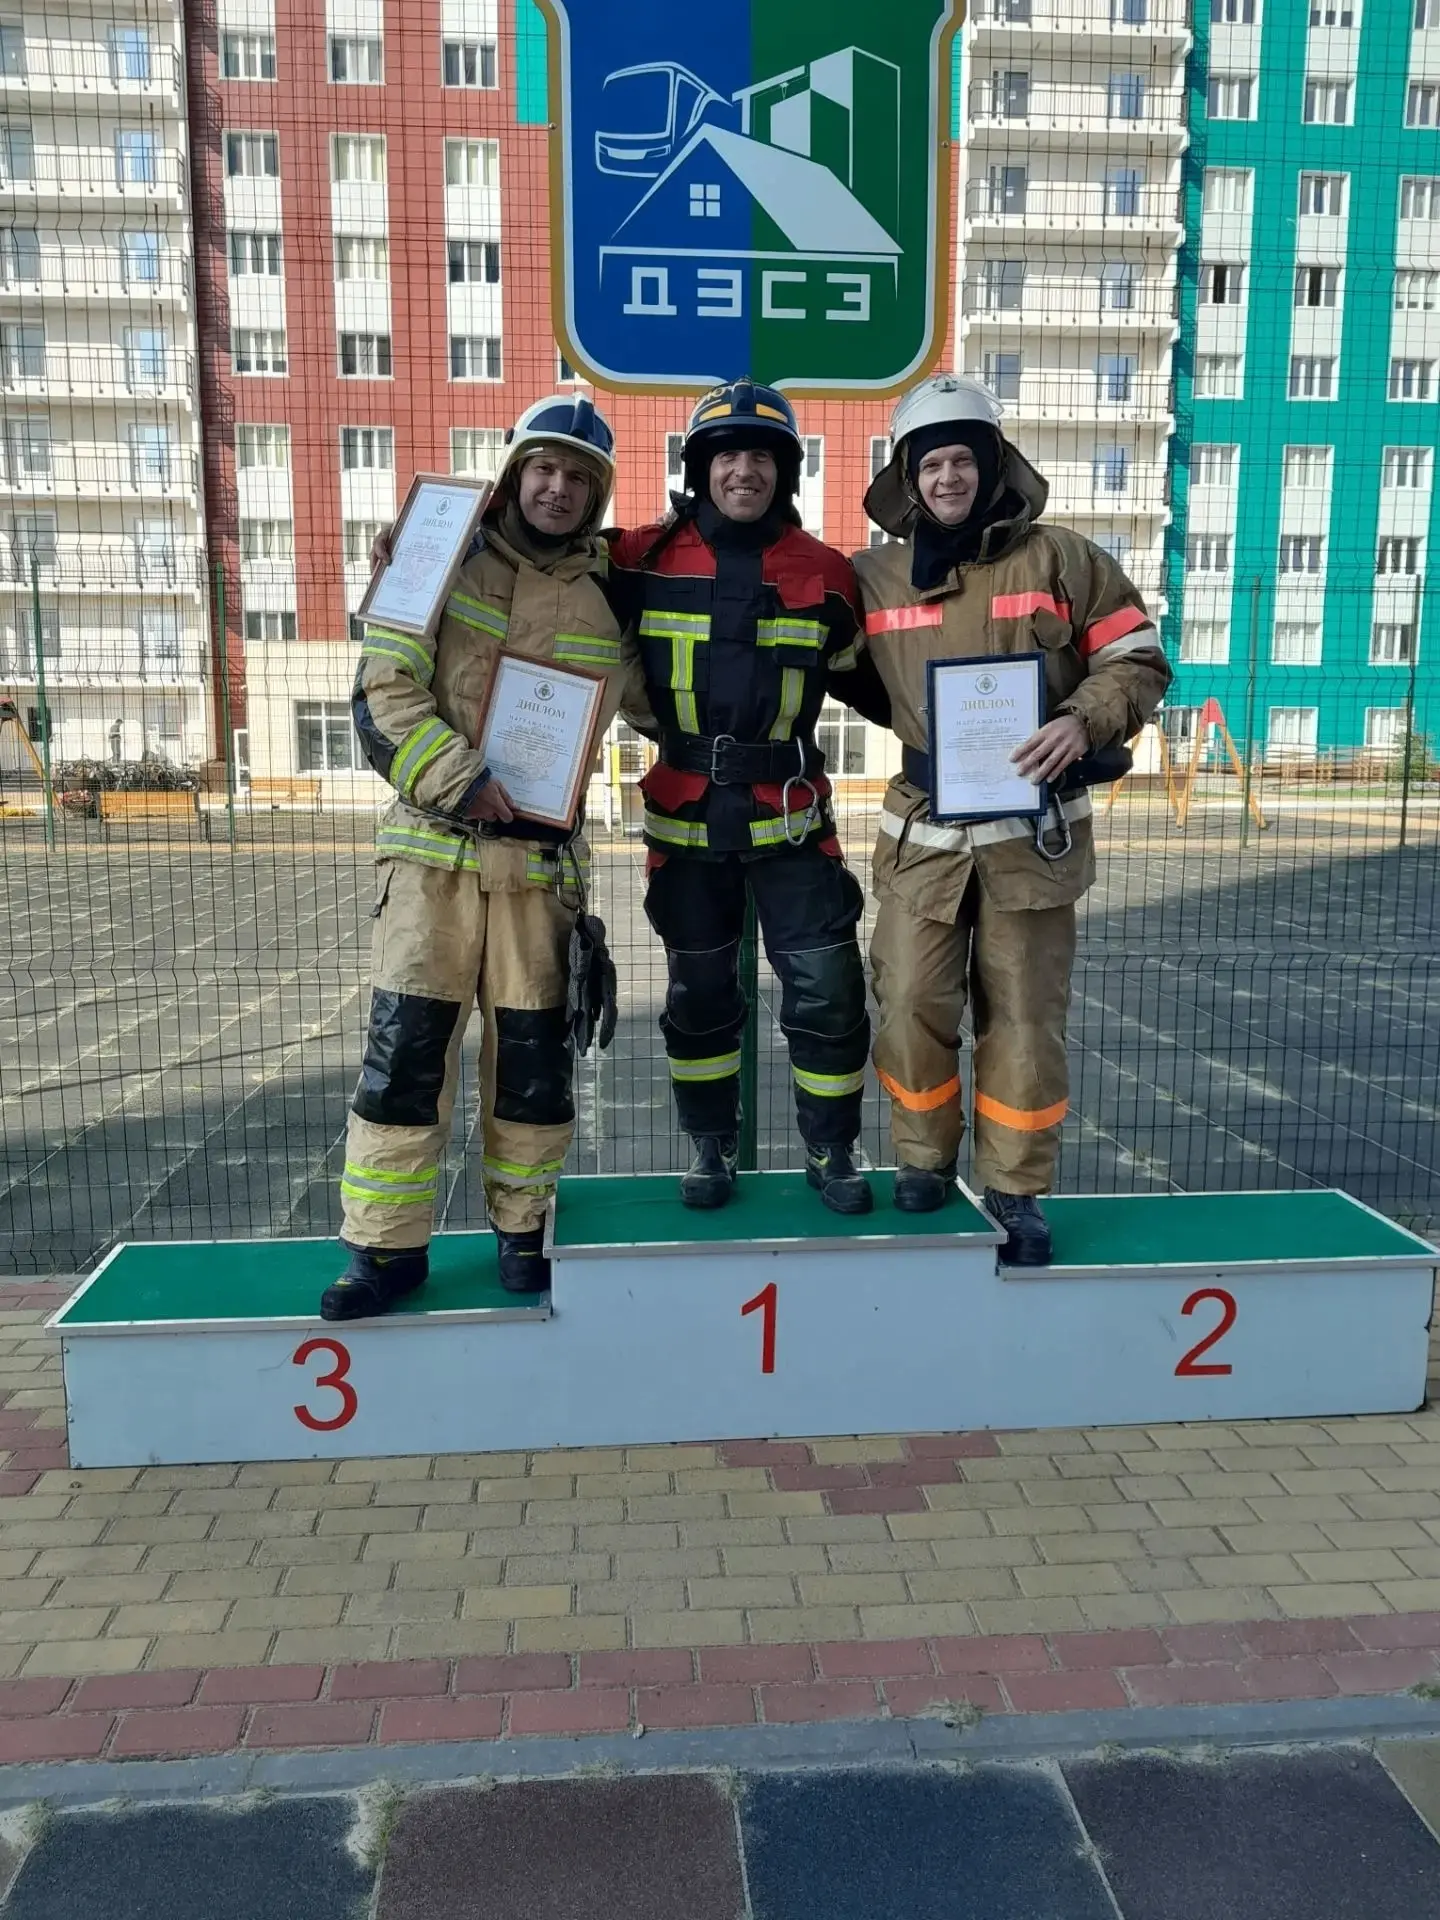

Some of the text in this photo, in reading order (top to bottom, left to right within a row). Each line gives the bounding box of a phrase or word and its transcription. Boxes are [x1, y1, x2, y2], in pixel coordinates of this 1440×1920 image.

[515, 698, 566, 720] ДИПЛОМ
[960, 698, 1015, 711] ДИПЛОМ
[741, 1284, 776, 1373] 1
[1176, 1288, 1236, 1376] 2
[294, 1339, 357, 1430] 3
